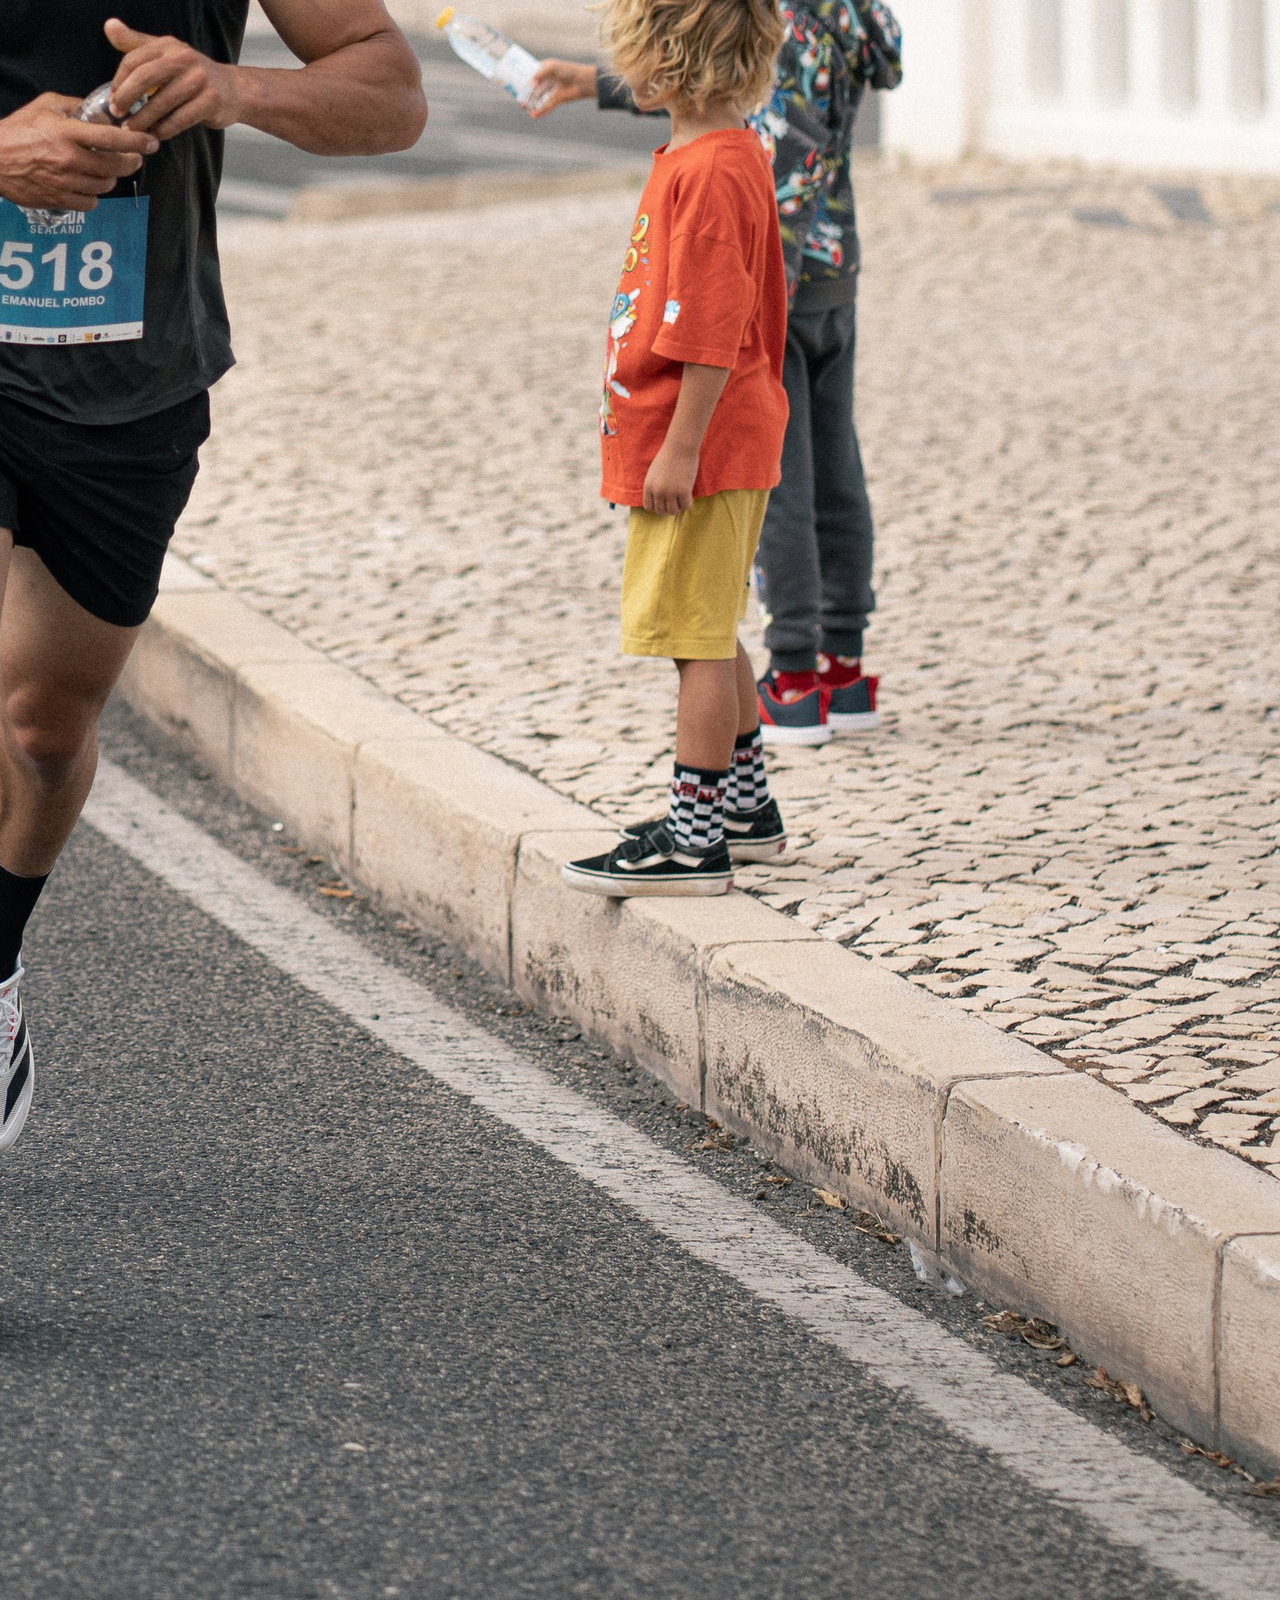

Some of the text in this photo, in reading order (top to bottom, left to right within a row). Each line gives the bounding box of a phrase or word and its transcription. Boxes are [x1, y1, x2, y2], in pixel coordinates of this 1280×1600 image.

[29, 225, 83, 235] SEALAND
[1, 294, 106, 308] EMANUEL POMBO
